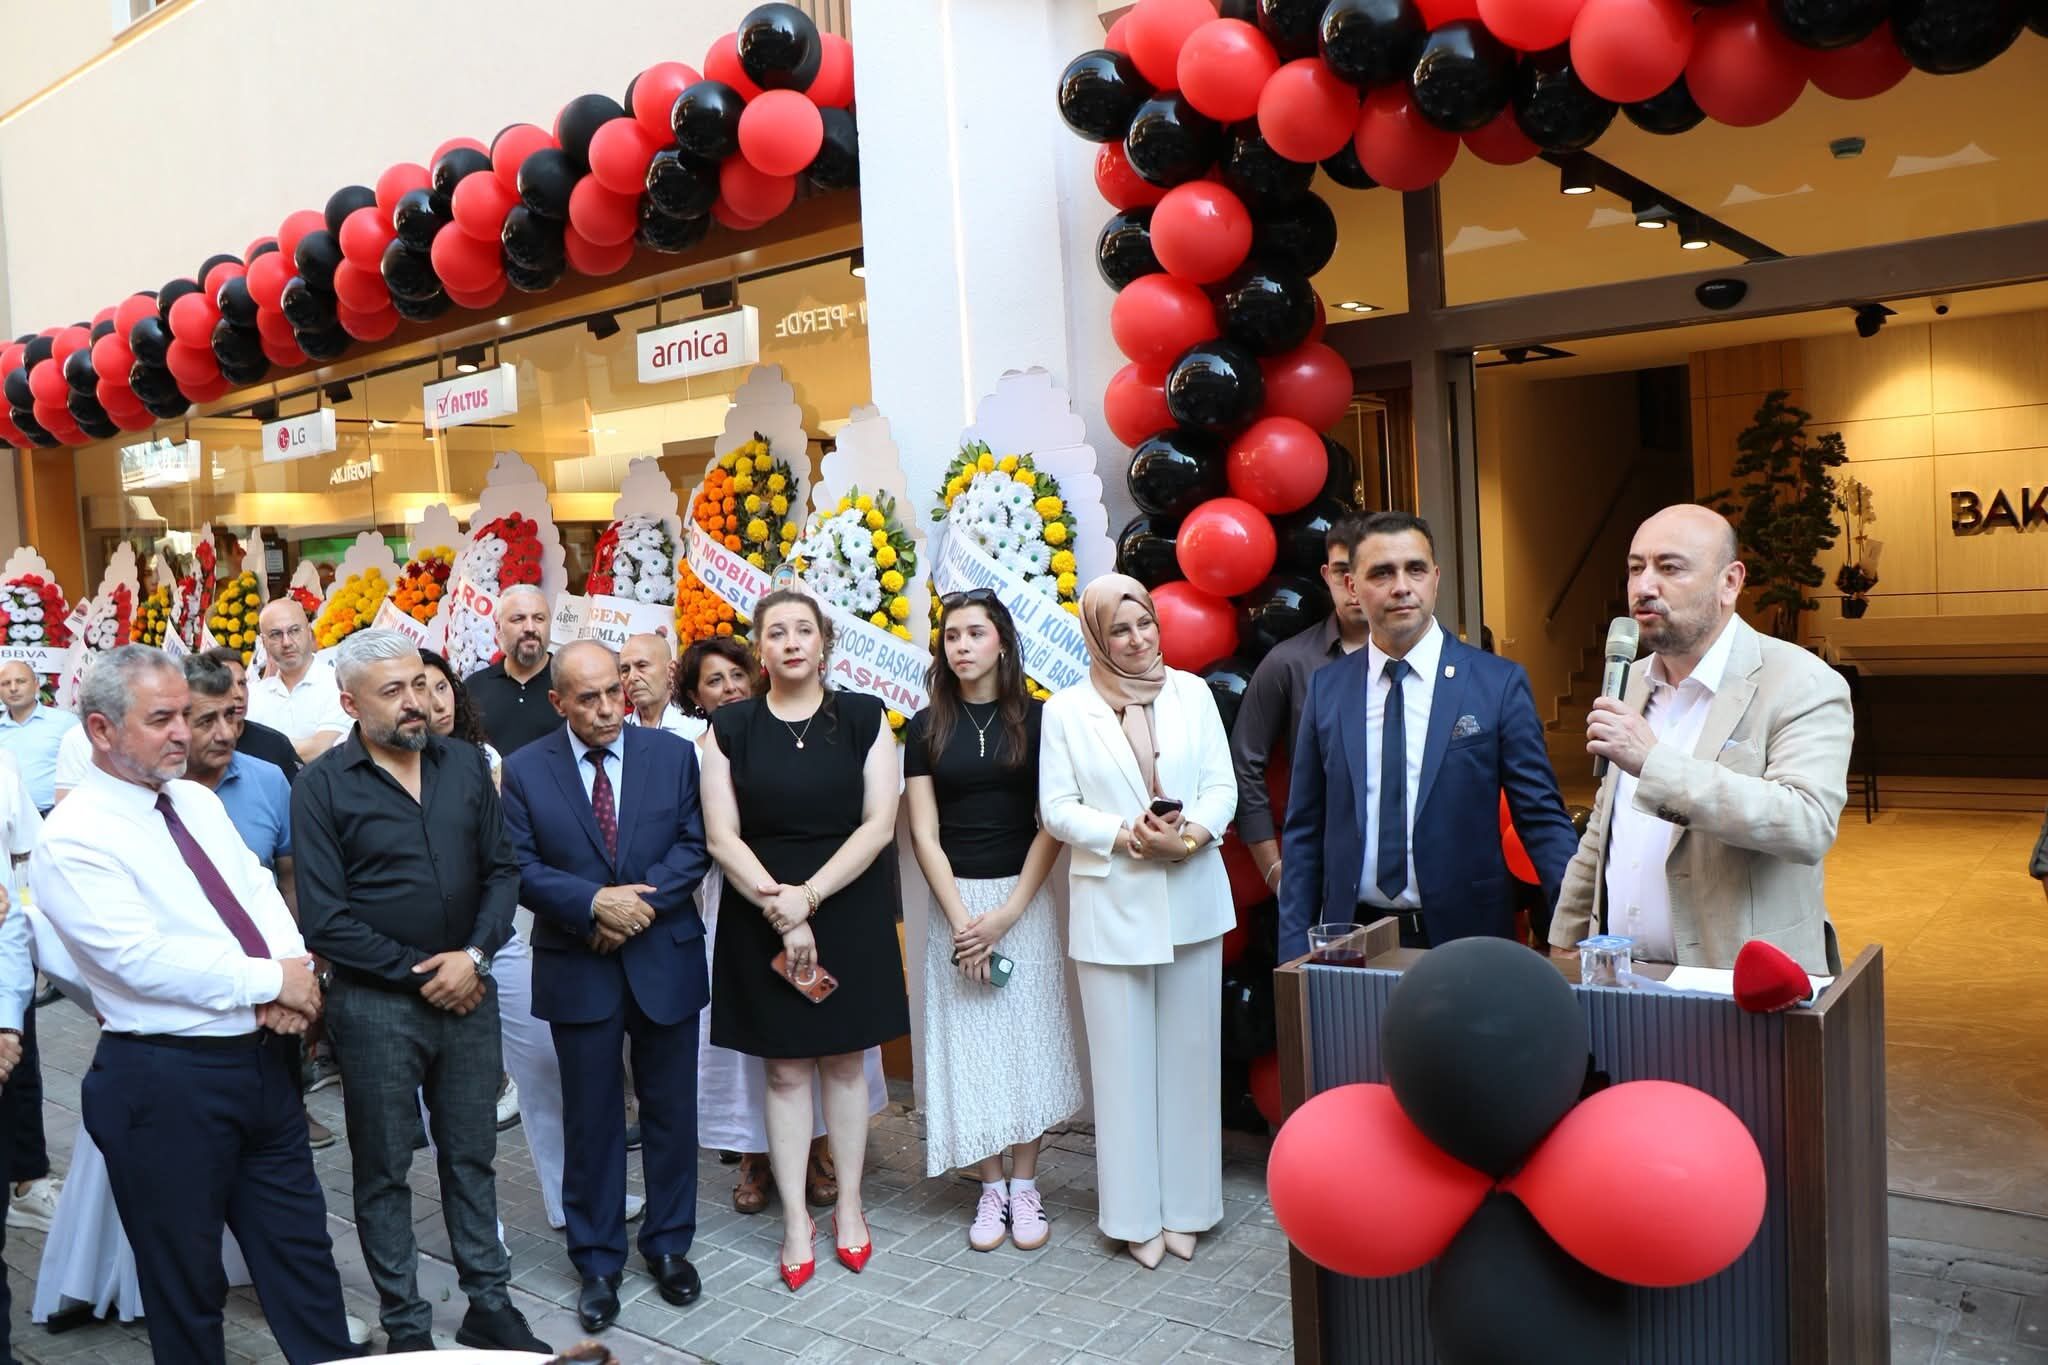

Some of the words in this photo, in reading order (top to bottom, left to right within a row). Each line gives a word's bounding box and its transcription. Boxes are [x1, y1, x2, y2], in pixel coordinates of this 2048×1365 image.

[652, 329, 728, 368] arnica
[451, 388, 488, 414] ALTUS
[292, 427, 306, 446] LG
[1951, 486, 2048, 536] BAK
[1007, 594, 1042, 624] ALİ
[834, 658, 920, 711] AŞKIN
